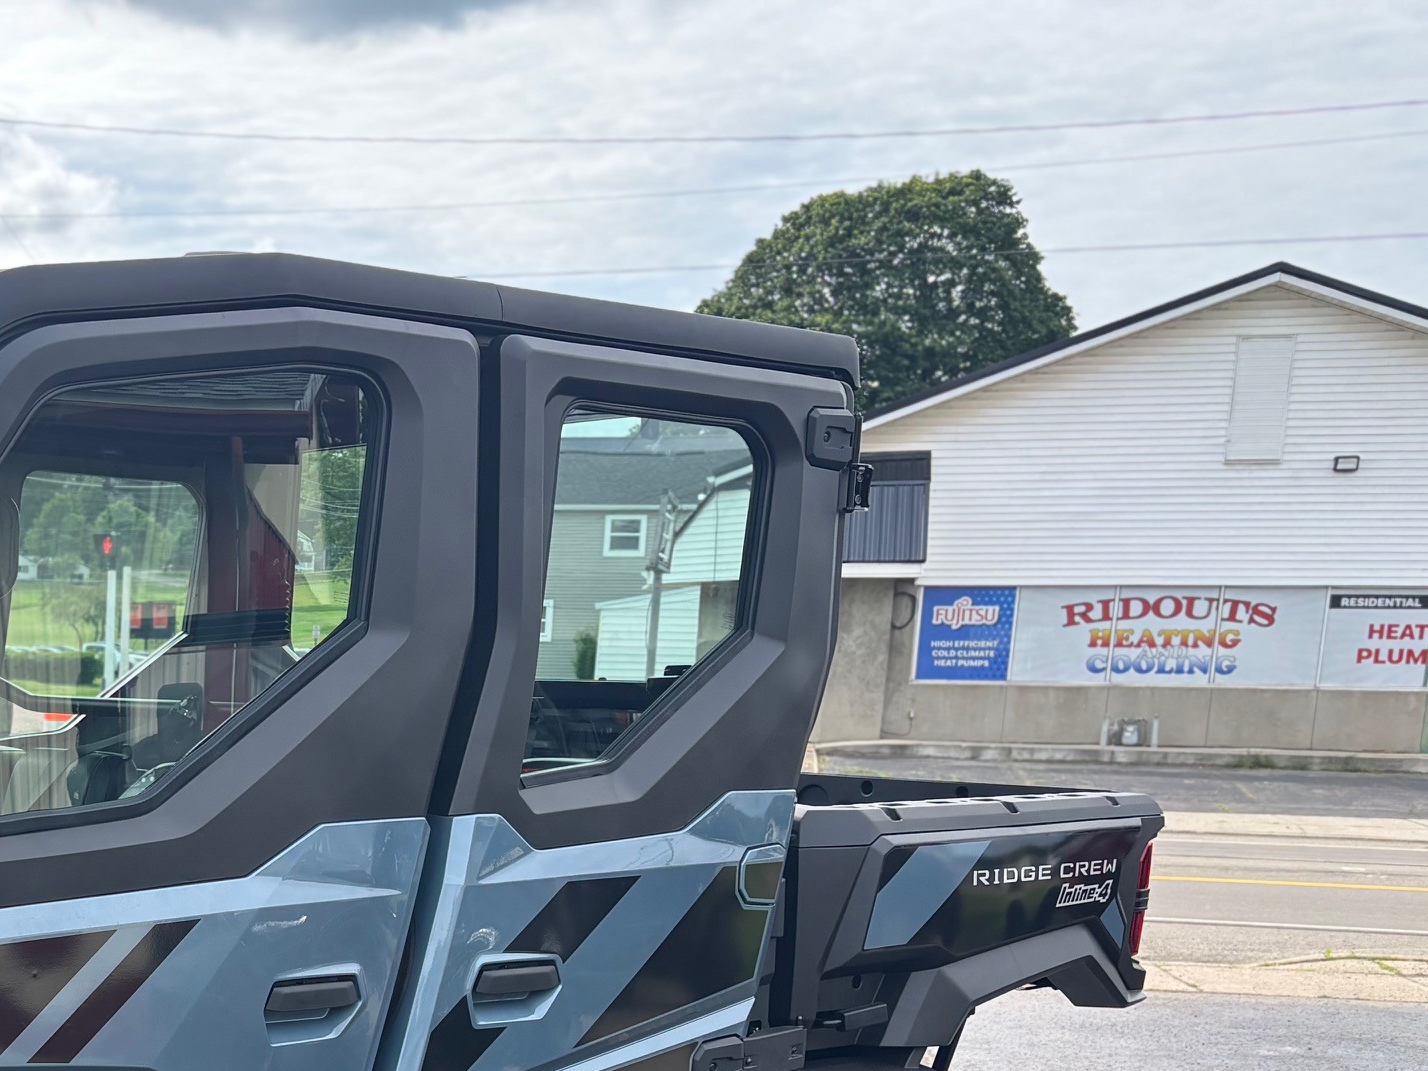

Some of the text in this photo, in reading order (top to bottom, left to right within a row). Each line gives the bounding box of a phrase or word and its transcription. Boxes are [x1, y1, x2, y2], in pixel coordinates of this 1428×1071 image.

[1061, 595, 1278, 628] RIDOUTS
[1340, 597, 1422, 608] RESIDENTIAL
[933, 597, 998, 628] FUJITSU
[1087, 628, 1242, 650] HEATING
[1367, 623, 1428, 641] HEAT
[930, 640, 998, 648] HIGH EFFICIENT
[1137, 643, 1189, 661] AND
[932, 650, 995, 658] COLD CLIMATE
[1355, 647, 1428, 666] PLUM
[934, 659, 990, 668] HEAT PUMPS
[1085, 653, 1238, 676] COOLING
[973, 858, 1118, 886] RIDGE CREW
